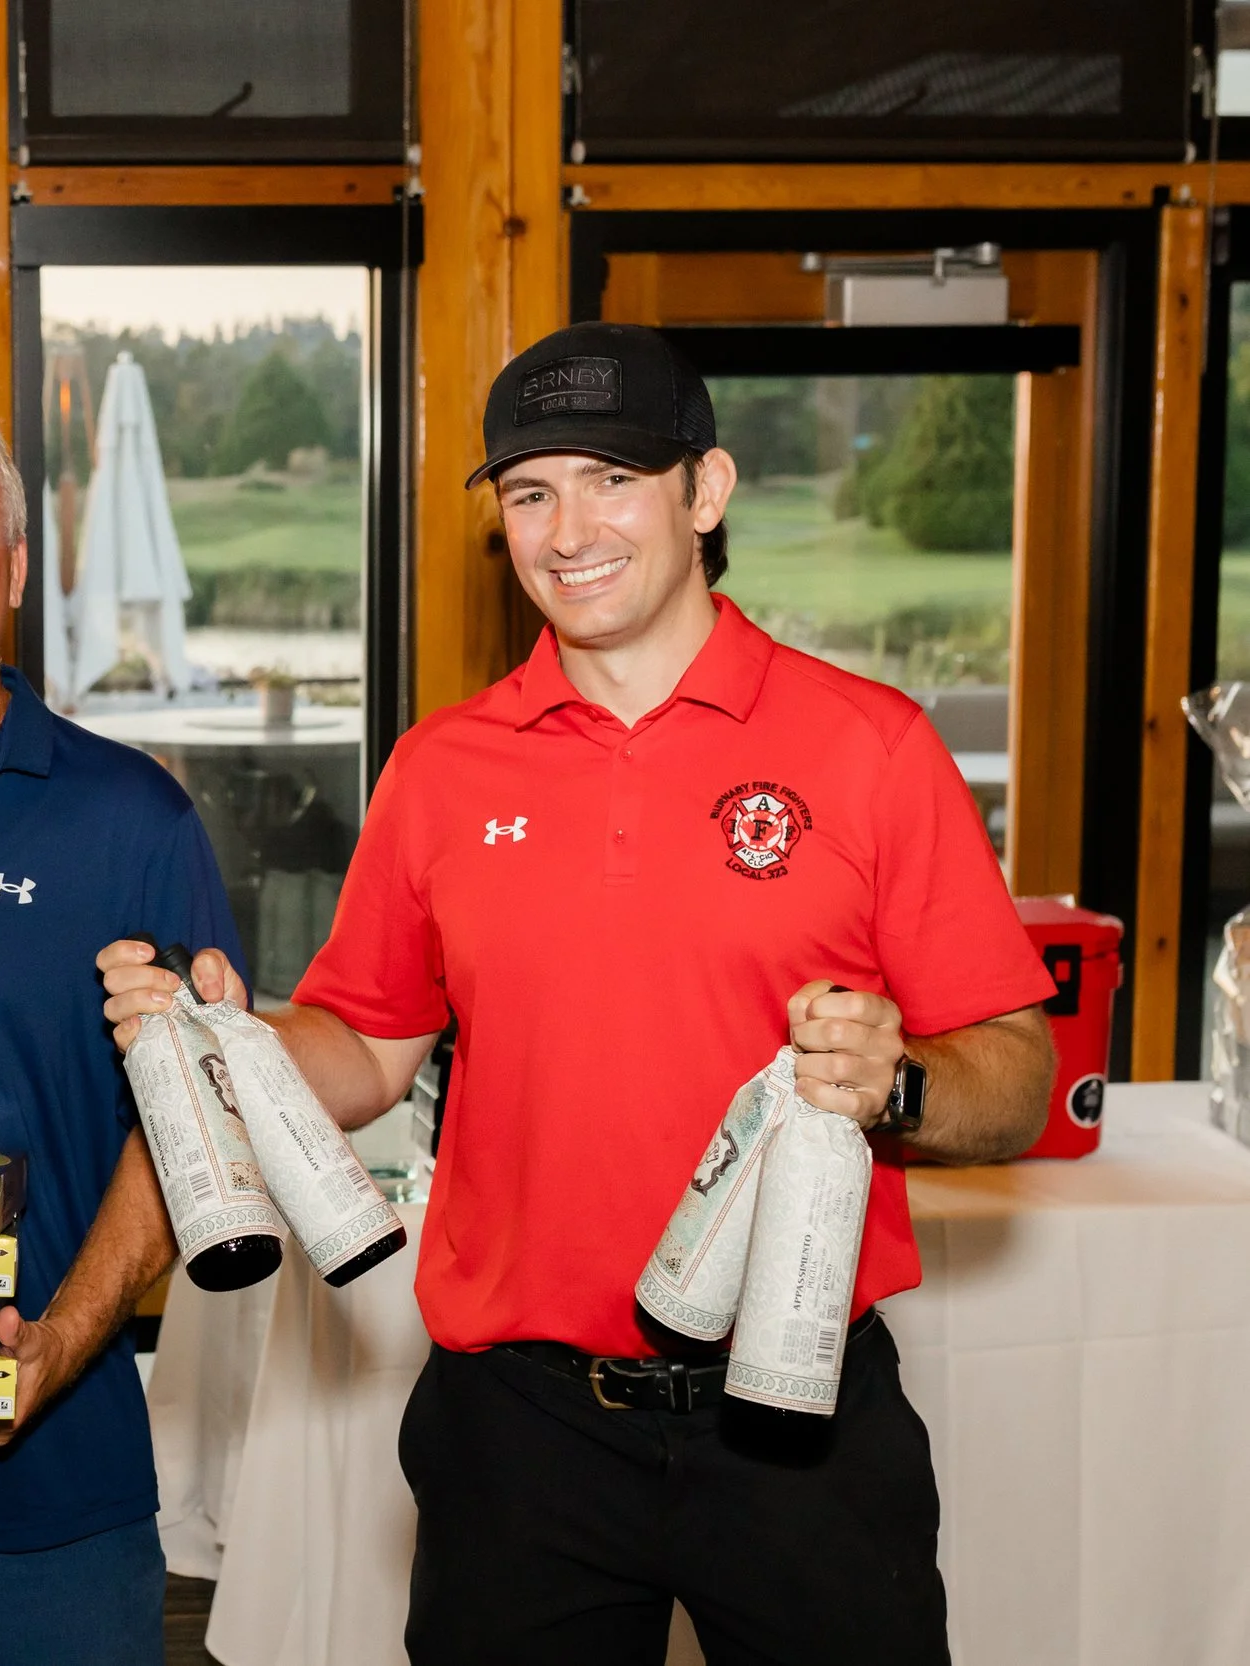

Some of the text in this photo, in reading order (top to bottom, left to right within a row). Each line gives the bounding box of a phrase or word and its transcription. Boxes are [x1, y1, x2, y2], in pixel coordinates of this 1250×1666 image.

[523, 367, 614, 397] BRNBY
[541, 396, 587, 411] LOCAL 323
[710, 781, 813, 830] BURNABY FIRE FIGHTERS
[756, 796, 770, 811] A
[741, 848, 774, 860] AFL-CIO
[748, 858, 764, 867] CLC
[726, 857, 766, 880] LOCAL
[277, 1110, 320, 1173] APPASSIMENTO
[791, 1233, 813, 1311] APPASSIMENTO
[806, 1259, 818, 1288] PUGLIA
[822, 1263, 833, 1290] ROSSO
